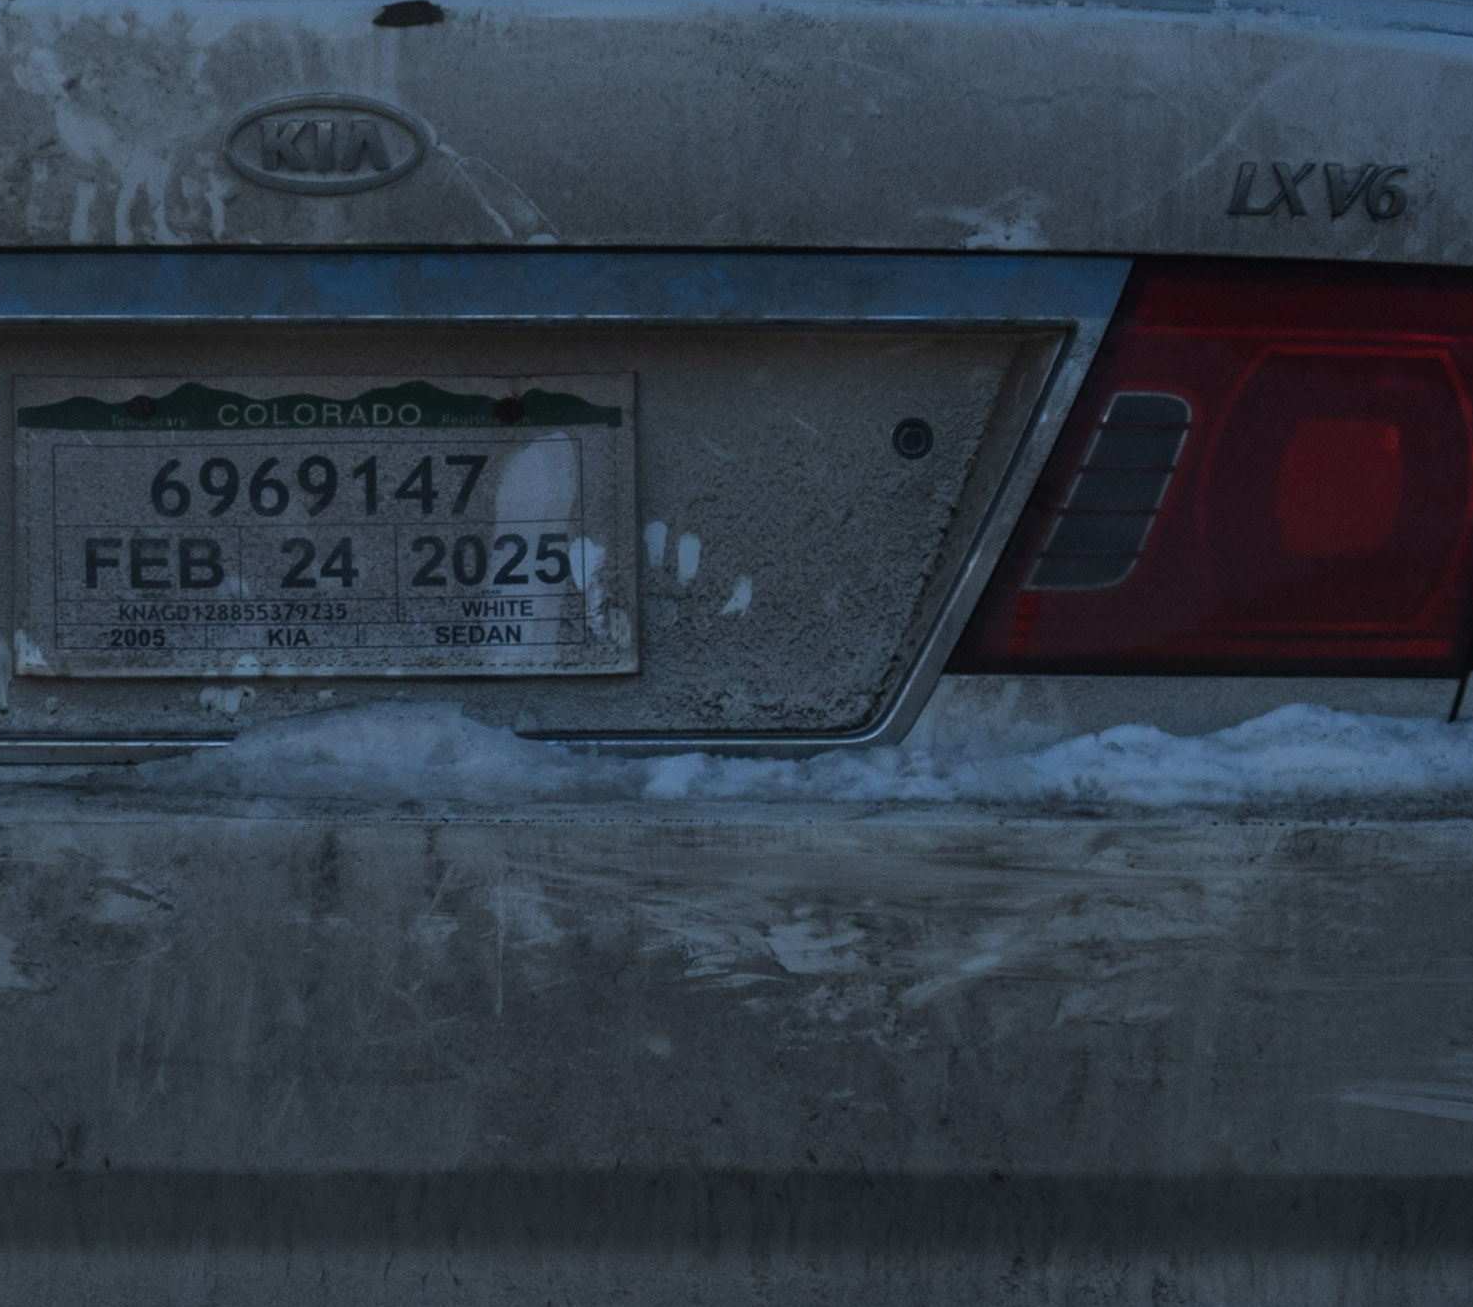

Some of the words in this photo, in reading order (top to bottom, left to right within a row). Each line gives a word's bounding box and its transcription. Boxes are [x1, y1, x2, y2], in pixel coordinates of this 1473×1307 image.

[259, 118, 391, 172] KIA
[217, 402, 423, 427] COLORADO
[150, 454, 489, 518] 6969147
[85, 537, 225, 589] FEB
[279, 536, 359, 588] 24
[410, 532, 572, 587] 2025
[118, 602, 348, 622] KNAGD128855379235
[461, 599, 534, 618] WHITE
[109, 628, 166, 647] 2005
[267, 628, 311, 647] KIA
[434, 624, 522, 644] SEDAN
